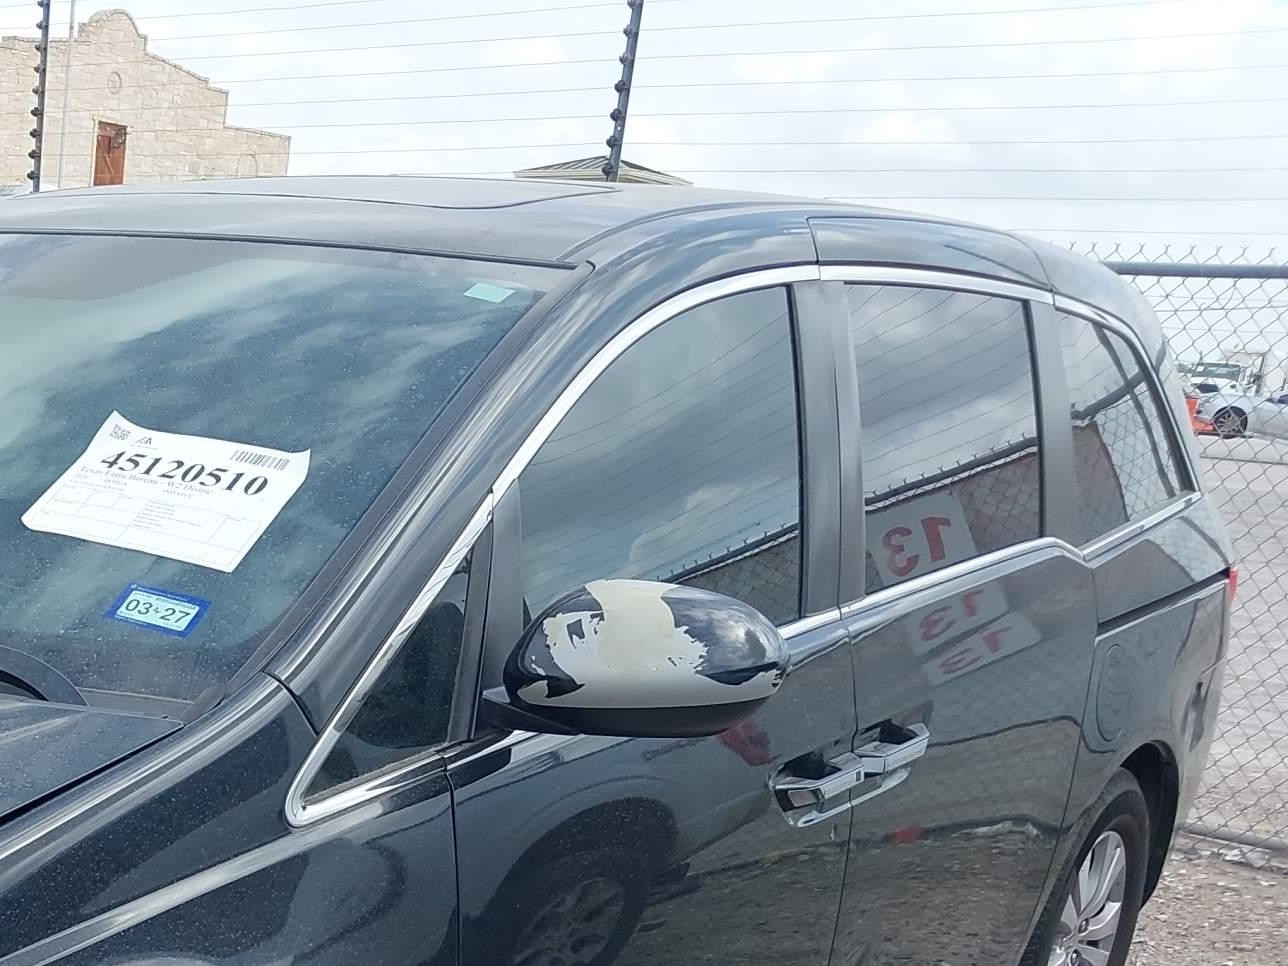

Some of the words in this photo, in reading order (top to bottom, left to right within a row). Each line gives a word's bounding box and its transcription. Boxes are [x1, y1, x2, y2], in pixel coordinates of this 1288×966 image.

[100, 450, 269, 496] 45120510
[125, 598, 153, 615] 03
[159, 607, 191, 624] 27
